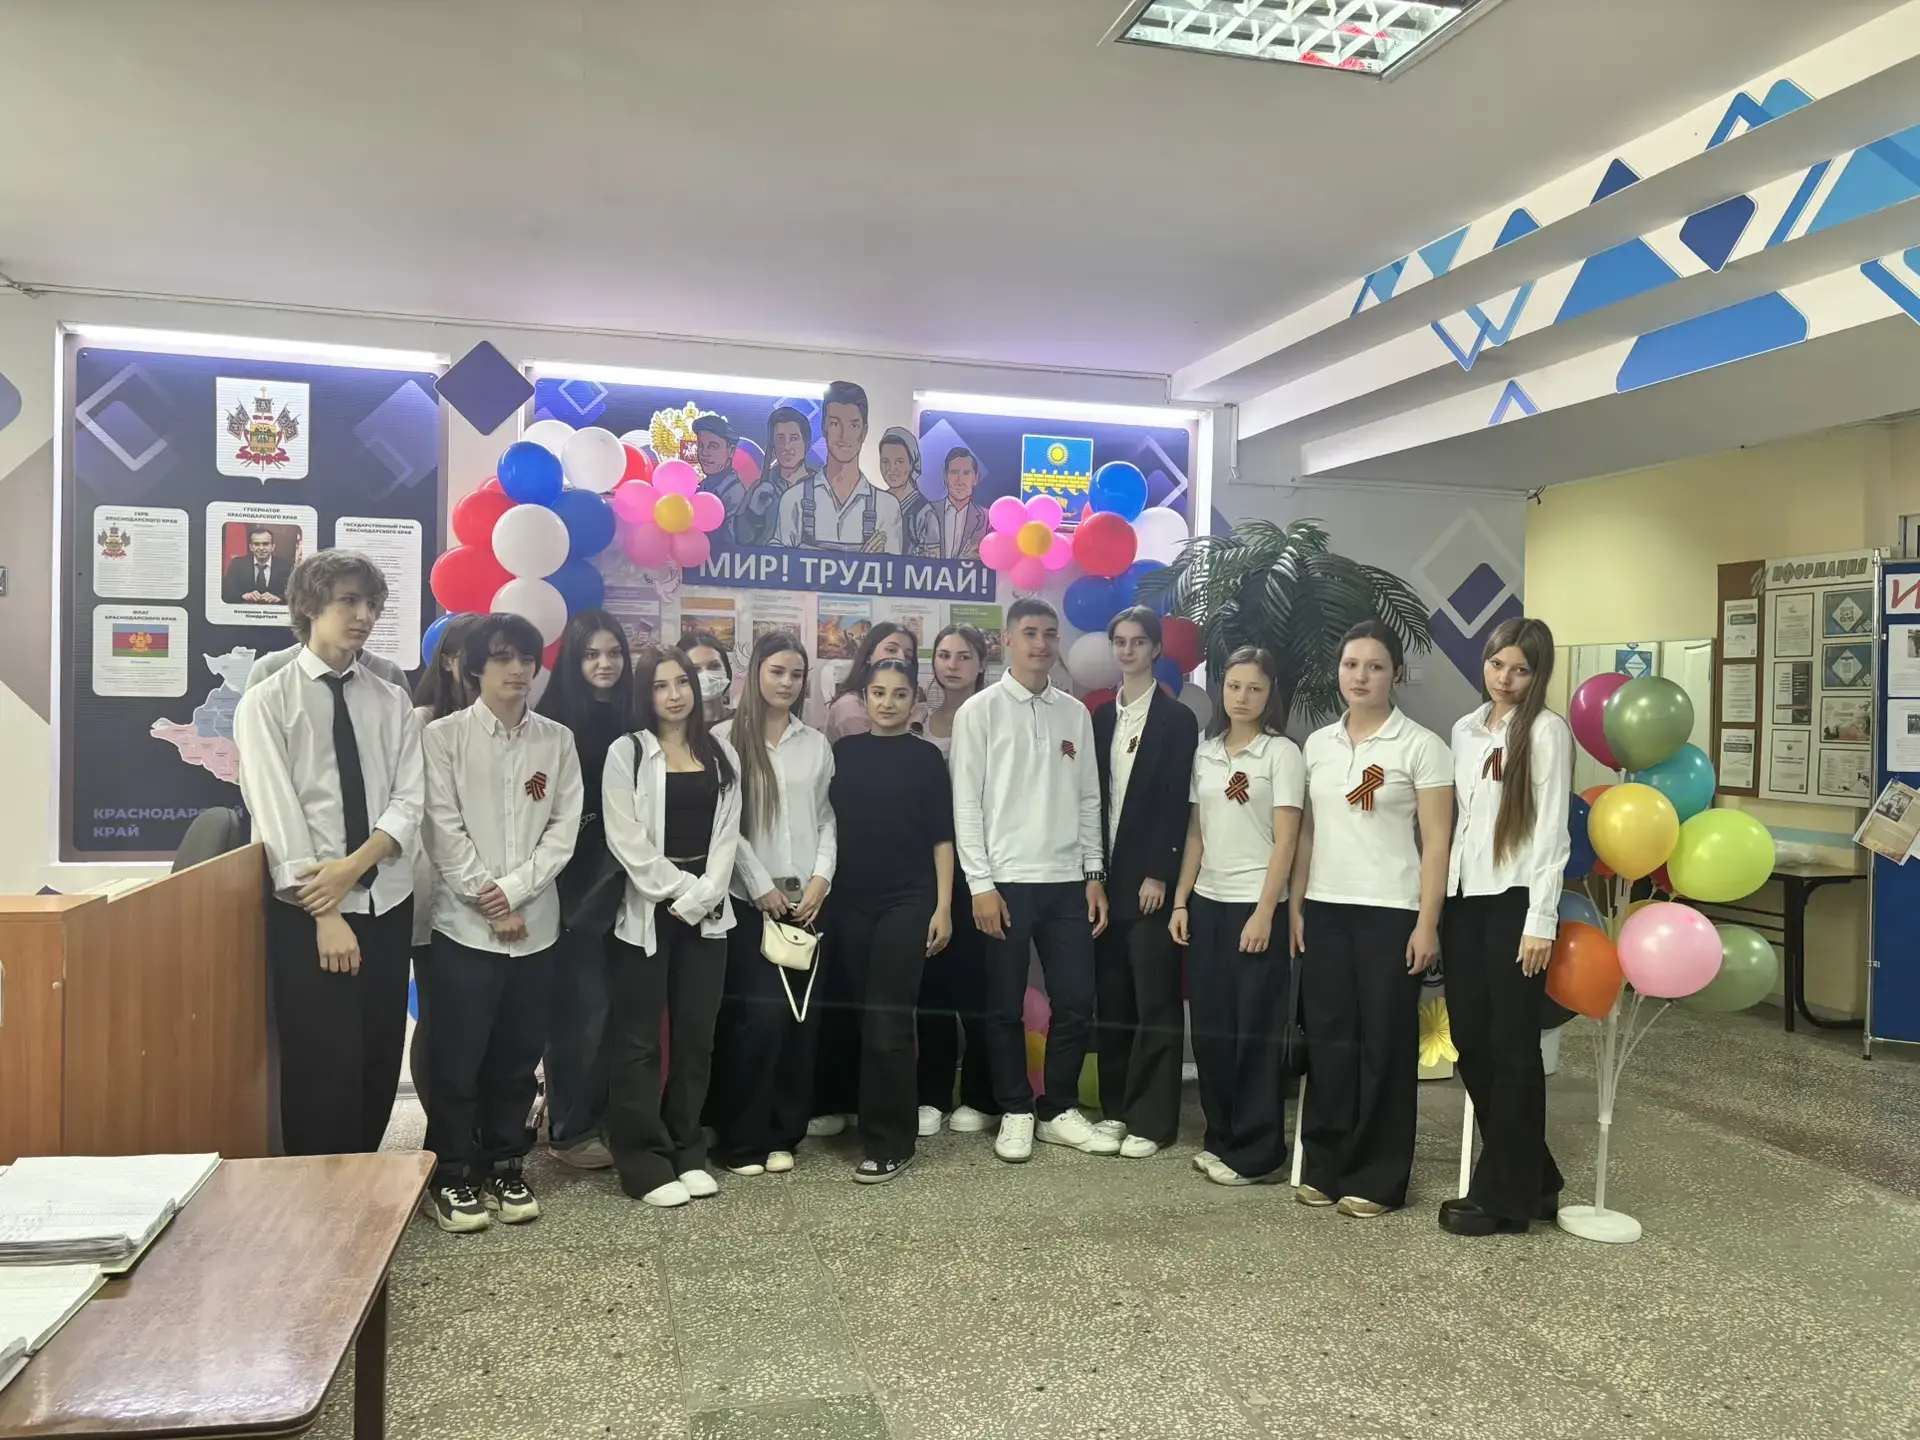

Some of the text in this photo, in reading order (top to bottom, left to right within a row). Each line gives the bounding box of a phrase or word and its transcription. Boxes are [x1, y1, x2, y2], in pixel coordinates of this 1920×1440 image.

[700, 552, 988, 594] МИР! ТРУД! МАЙ!
[93, 805, 244, 819] КРАСНОДАРЙ
[93, 824, 139, 837] КРАЙ
